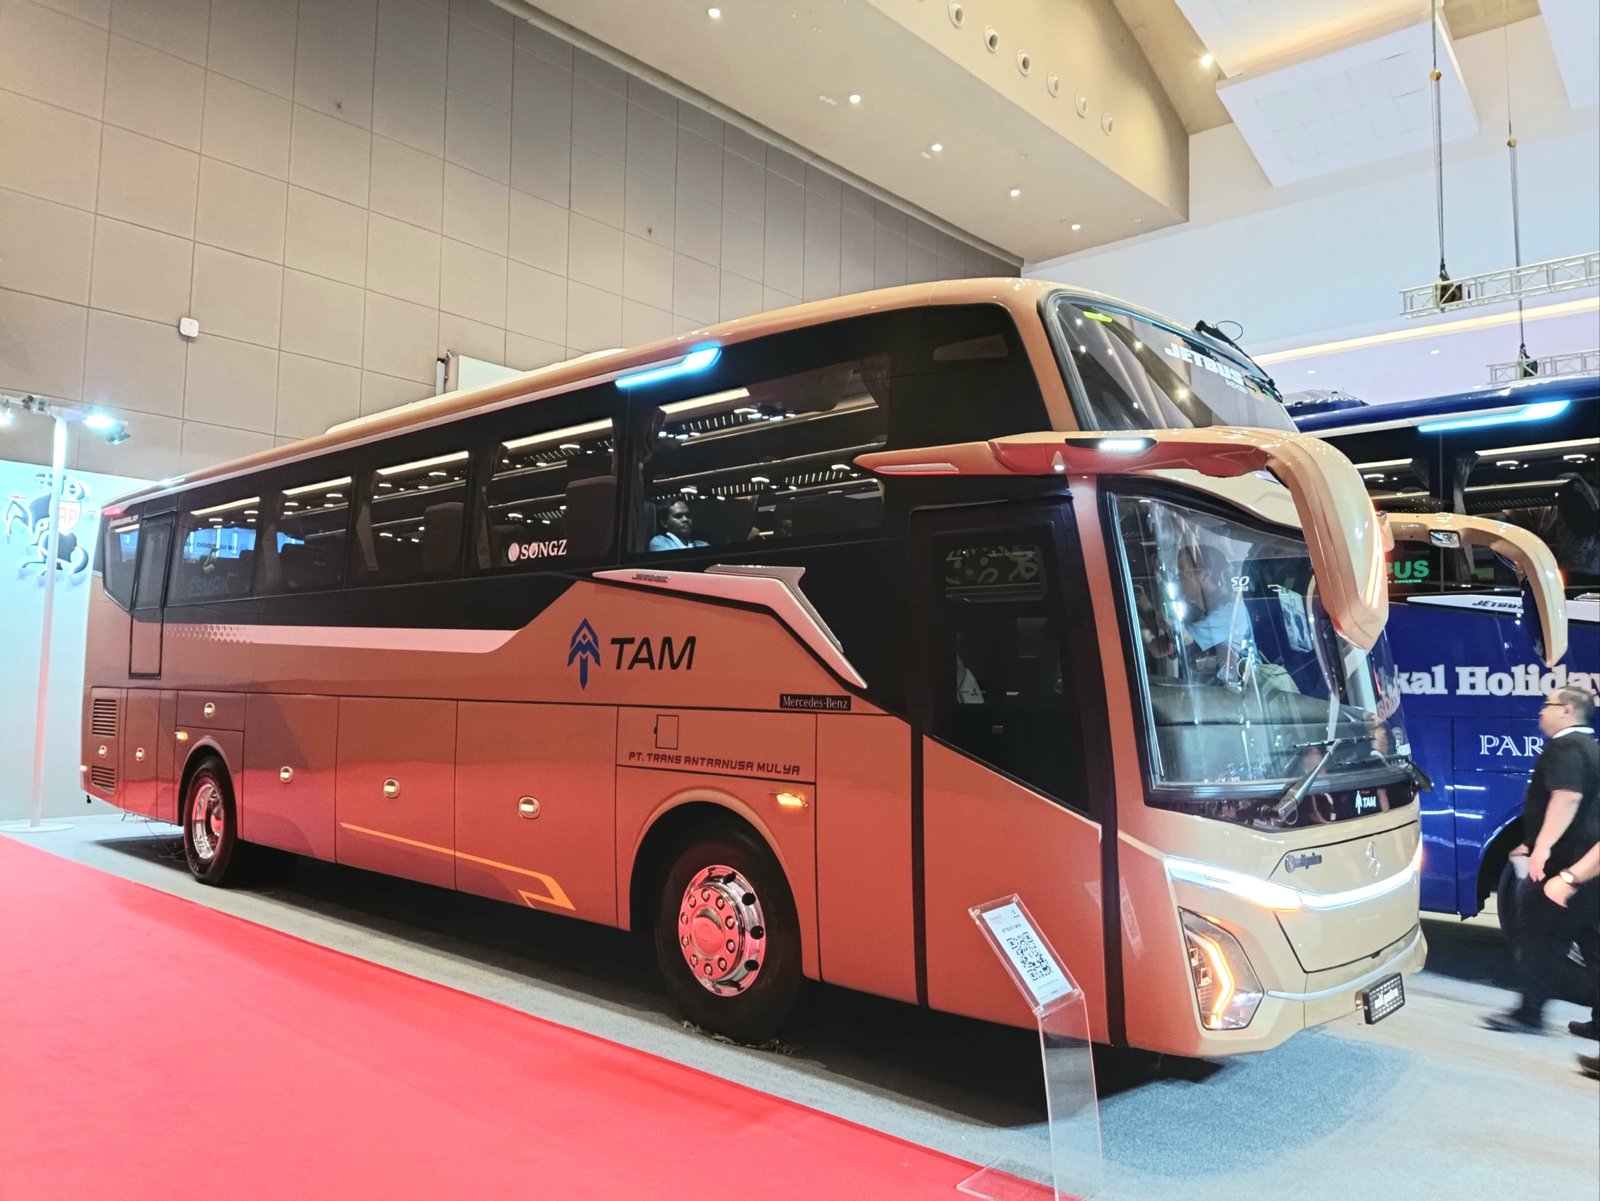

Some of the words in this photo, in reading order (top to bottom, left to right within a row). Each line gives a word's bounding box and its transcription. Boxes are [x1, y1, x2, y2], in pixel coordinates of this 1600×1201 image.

[1164, 342, 1244, 386] JETBUS
[520, 539, 567, 560] SONGZ
[610, 636, 696, 671] TAM
[782, 695, 849, 710] Mercedes-Benz
[1479, 734, 1545, 757] PAR
[628, 751, 644, 761] PT.
[647, 752, 682, 764] TRANS
[684, 756, 754, 771] ANTARNUSA
[756, 762, 800, 776] MULYA
[1363, 796, 1377, 808] TAM
